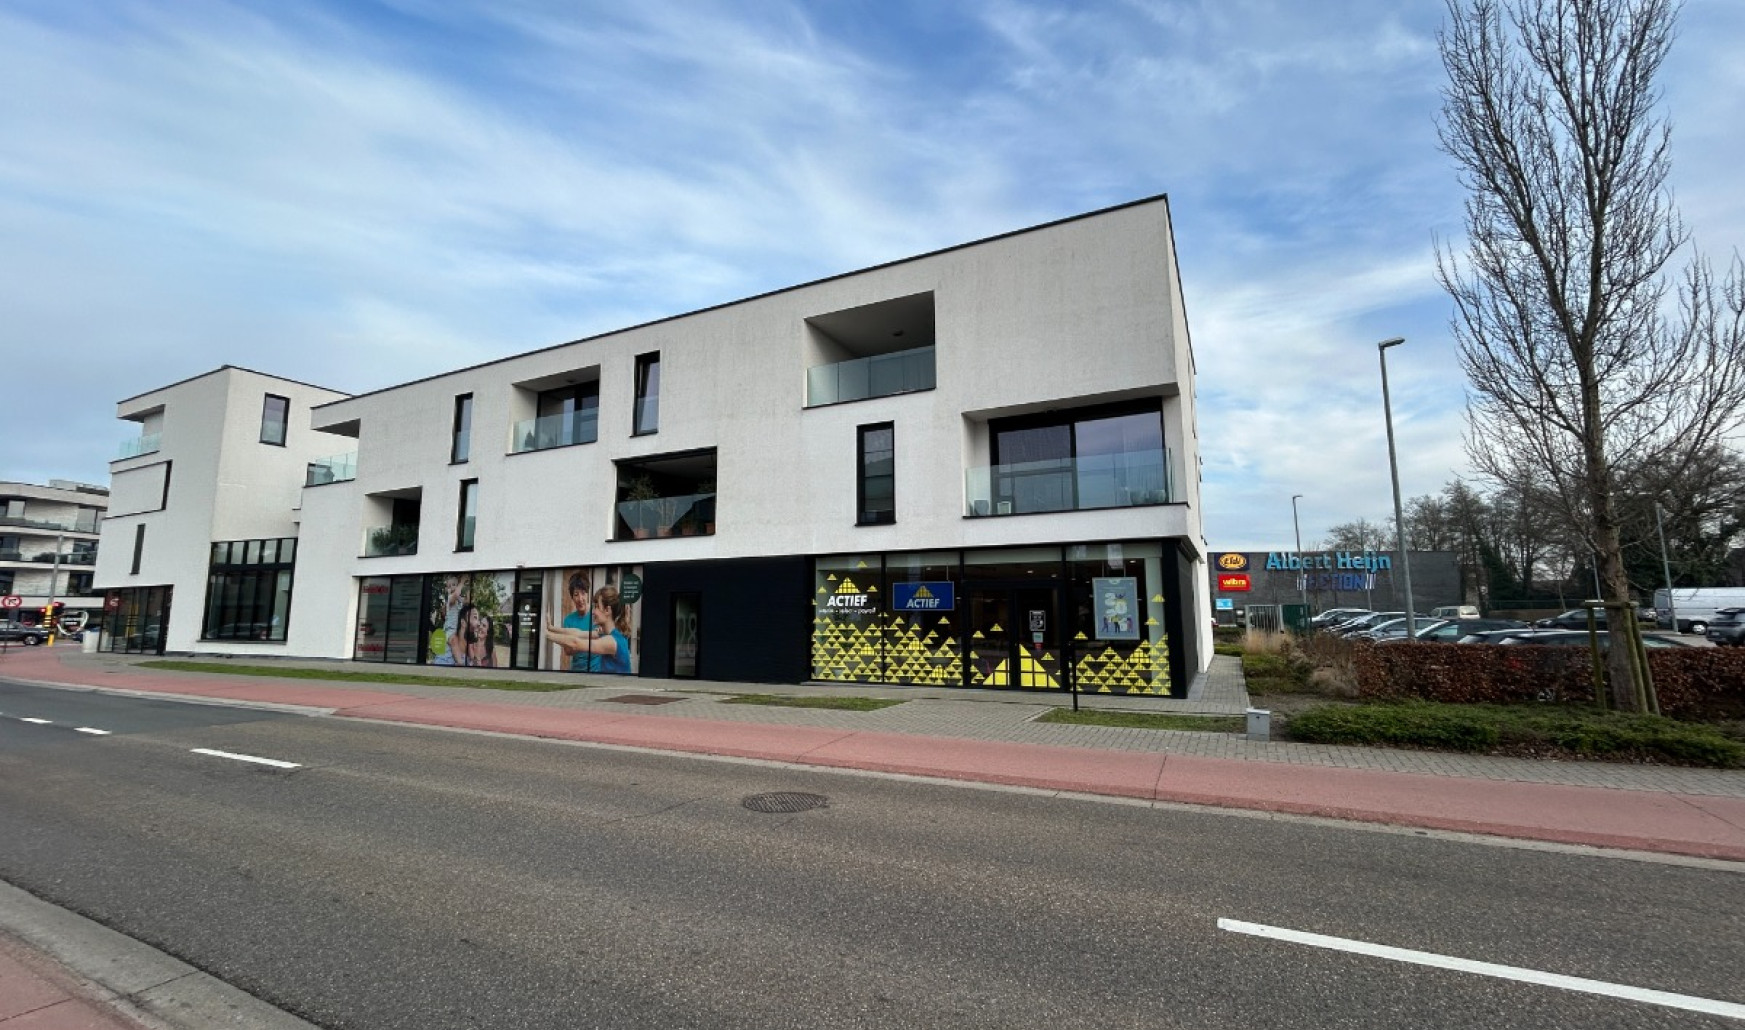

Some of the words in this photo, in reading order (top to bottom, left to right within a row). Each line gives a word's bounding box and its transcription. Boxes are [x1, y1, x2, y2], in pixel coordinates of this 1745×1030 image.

[1266, 551, 1332, 570] Albert
[1336, 551, 1392, 573] Heijn
[826, 594, 868, 607] ACTIEF
[906, 598, 940, 609] ACTIEF
